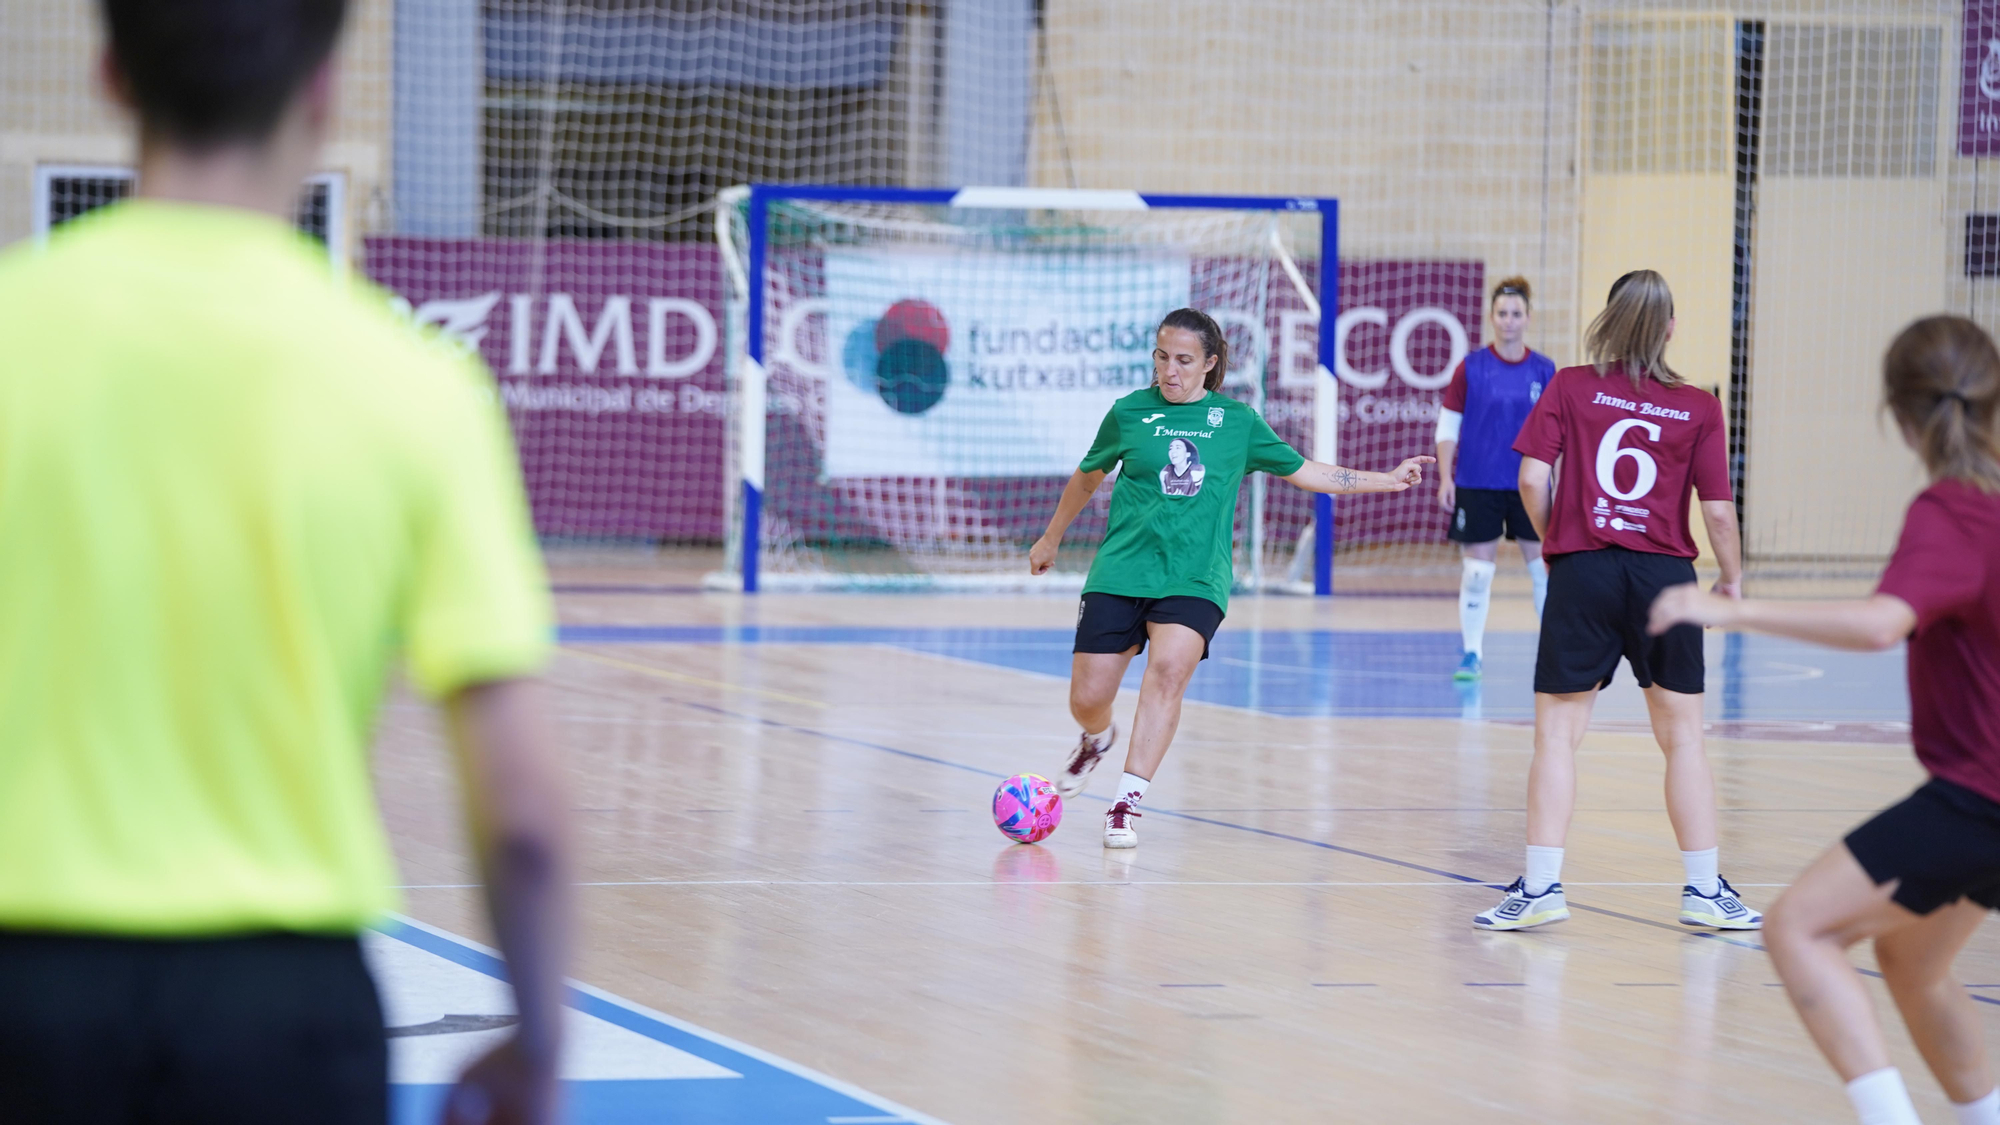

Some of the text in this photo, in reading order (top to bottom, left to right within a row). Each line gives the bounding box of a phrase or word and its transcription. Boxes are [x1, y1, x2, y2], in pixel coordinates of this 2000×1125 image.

[1209, 305, 1470, 391] DECO
[968, 360, 1149, 390] kutxaban
[1593, 392, 1690, 420] Inma Baena
[1162, 429, 1214, 438] Memorial
[1596, 418, 1661, 500] 6
